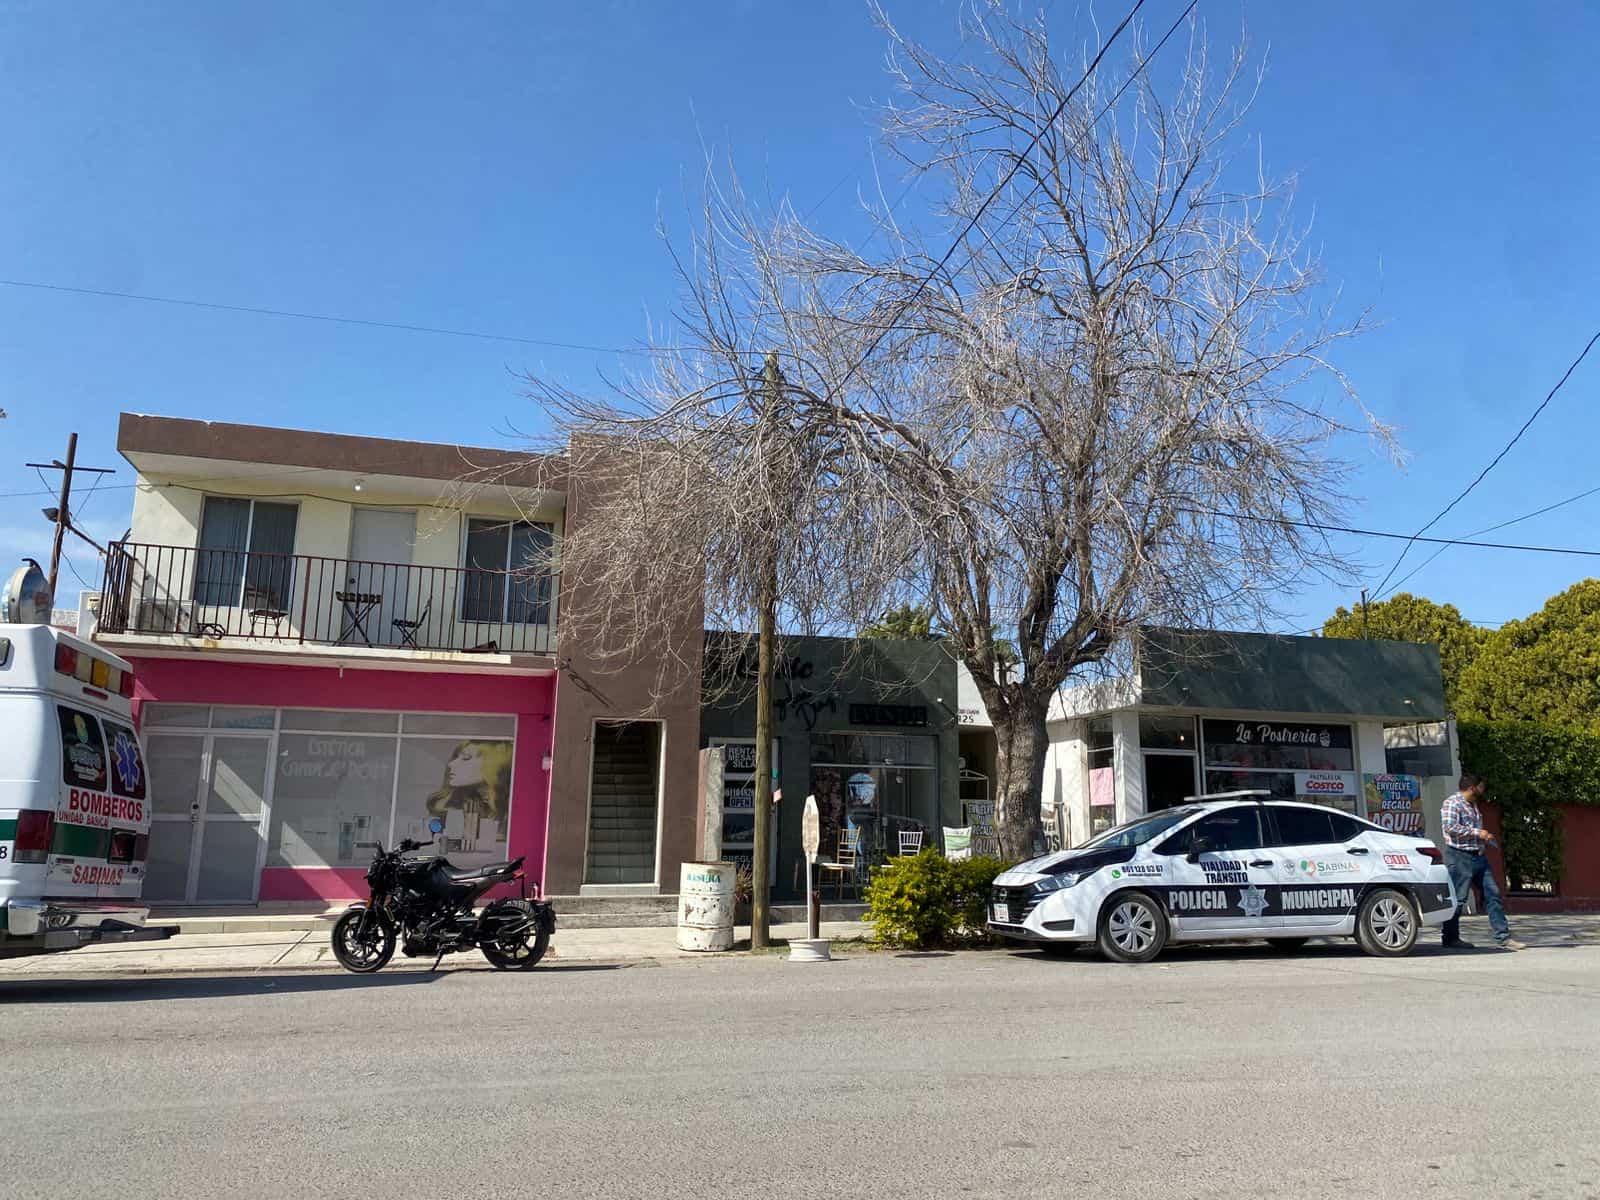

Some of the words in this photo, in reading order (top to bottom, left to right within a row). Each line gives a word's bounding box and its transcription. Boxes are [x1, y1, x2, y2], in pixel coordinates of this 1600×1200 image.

[1236, 723, 1251, 741] La
[1257, 724, 1317, 744] Postreria
[1306, 780, 1345, 790] COSTCO
[1376, 782, 1412, 791] ENVUELVE
[1391, 792, 1401, 800] TU
[69, 788, 143, 822] BOMBEROS
[1381, 800, 1412, 810] REGALO
[59, 811, 84, 824] UNIDAD
[86, 816, 109, 828] BASICA
[1200, 861, 1241, 871] VIALIDAD
[1242, 860, 1248, 870] Y
[71, 865, 124, 886] SABINAS
[1169, 891, 1228, 910] POLICIA
[1282, 888, 1357, 910] MUNICIPAL
